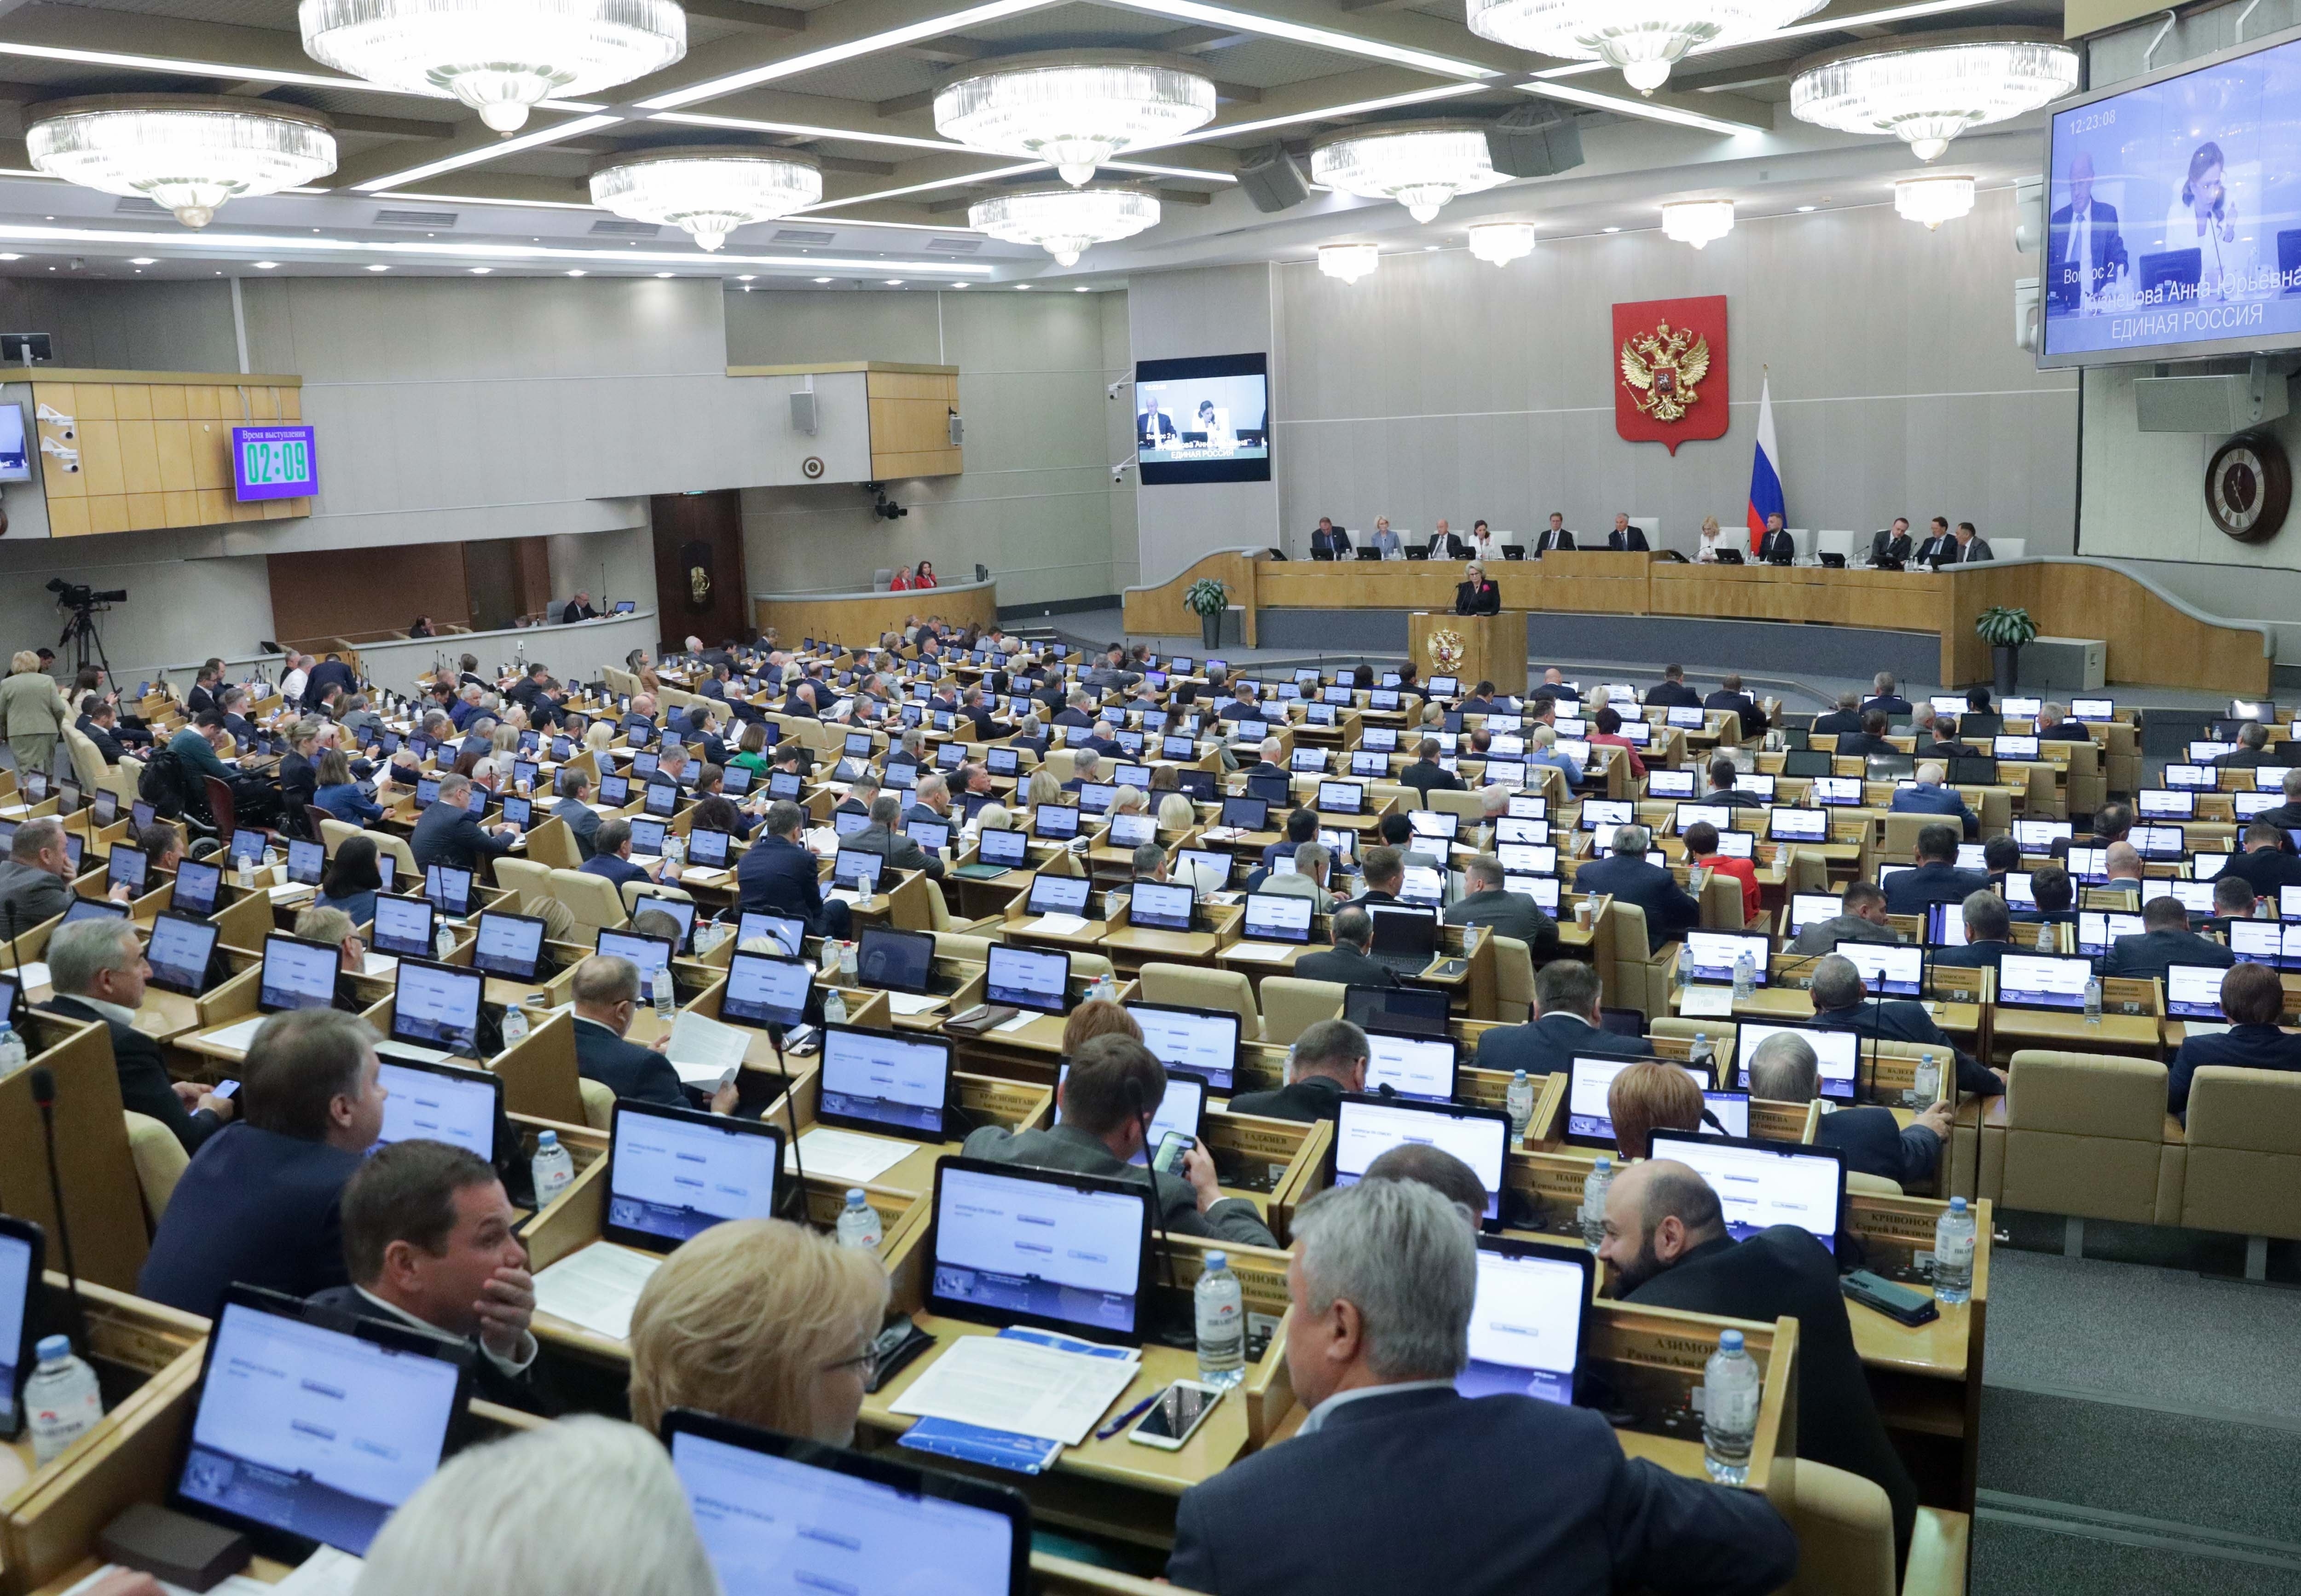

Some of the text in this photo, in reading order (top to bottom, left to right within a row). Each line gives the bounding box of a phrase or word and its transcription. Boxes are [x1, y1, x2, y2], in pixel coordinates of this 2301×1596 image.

[2070, 109, 2116, 135] 12:23:08
[2064, 262, 2114, 284] Вопос 2
[2168, 280, 2210, 301] Анна
[2112, 304, 2263, 342] ЕДИНАЯ РОССИЯ
[243, 430, 306, 441] Время выступления
[1171, 451, 1201, 459] ЕДИНАЯ
[247, 443, 306, 483] 02:09
[979, 1093, 1039, 1106] КРАСНОШТАНО
[1751, 1113, 1788, 1123] ИТРИЕВА
[1556, 1174, 1584, 1184] ПАНИ
[1891, 1226, 1935, 1238] Владими
